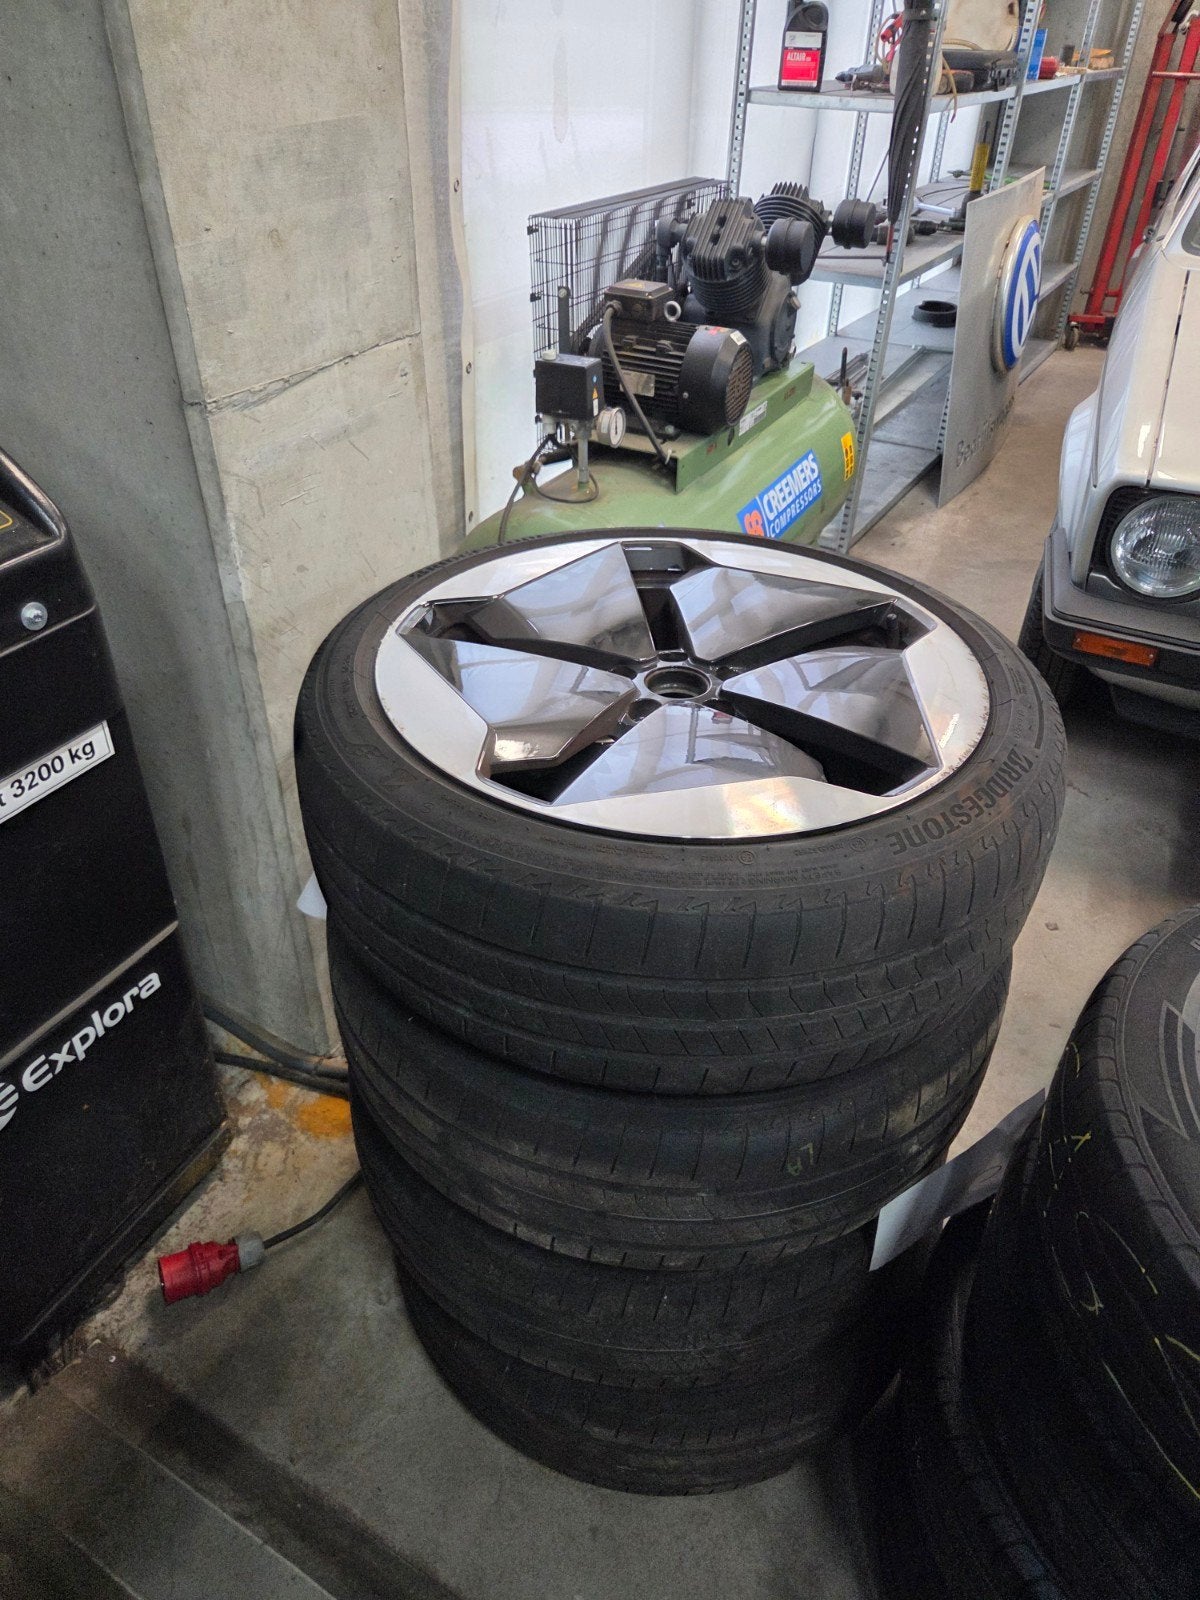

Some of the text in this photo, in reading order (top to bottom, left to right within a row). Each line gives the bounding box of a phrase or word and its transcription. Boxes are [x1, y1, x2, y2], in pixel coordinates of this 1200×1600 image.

[762, 453, 819, 521] CREEMERS
[769, 479, 822, 538] COMPRESSORS
[10, 740, 96, 799] 3200 kg
[885, 748, 1034, 856] BRIDGESTONE
[22, 972, 162, 1093] Explora
